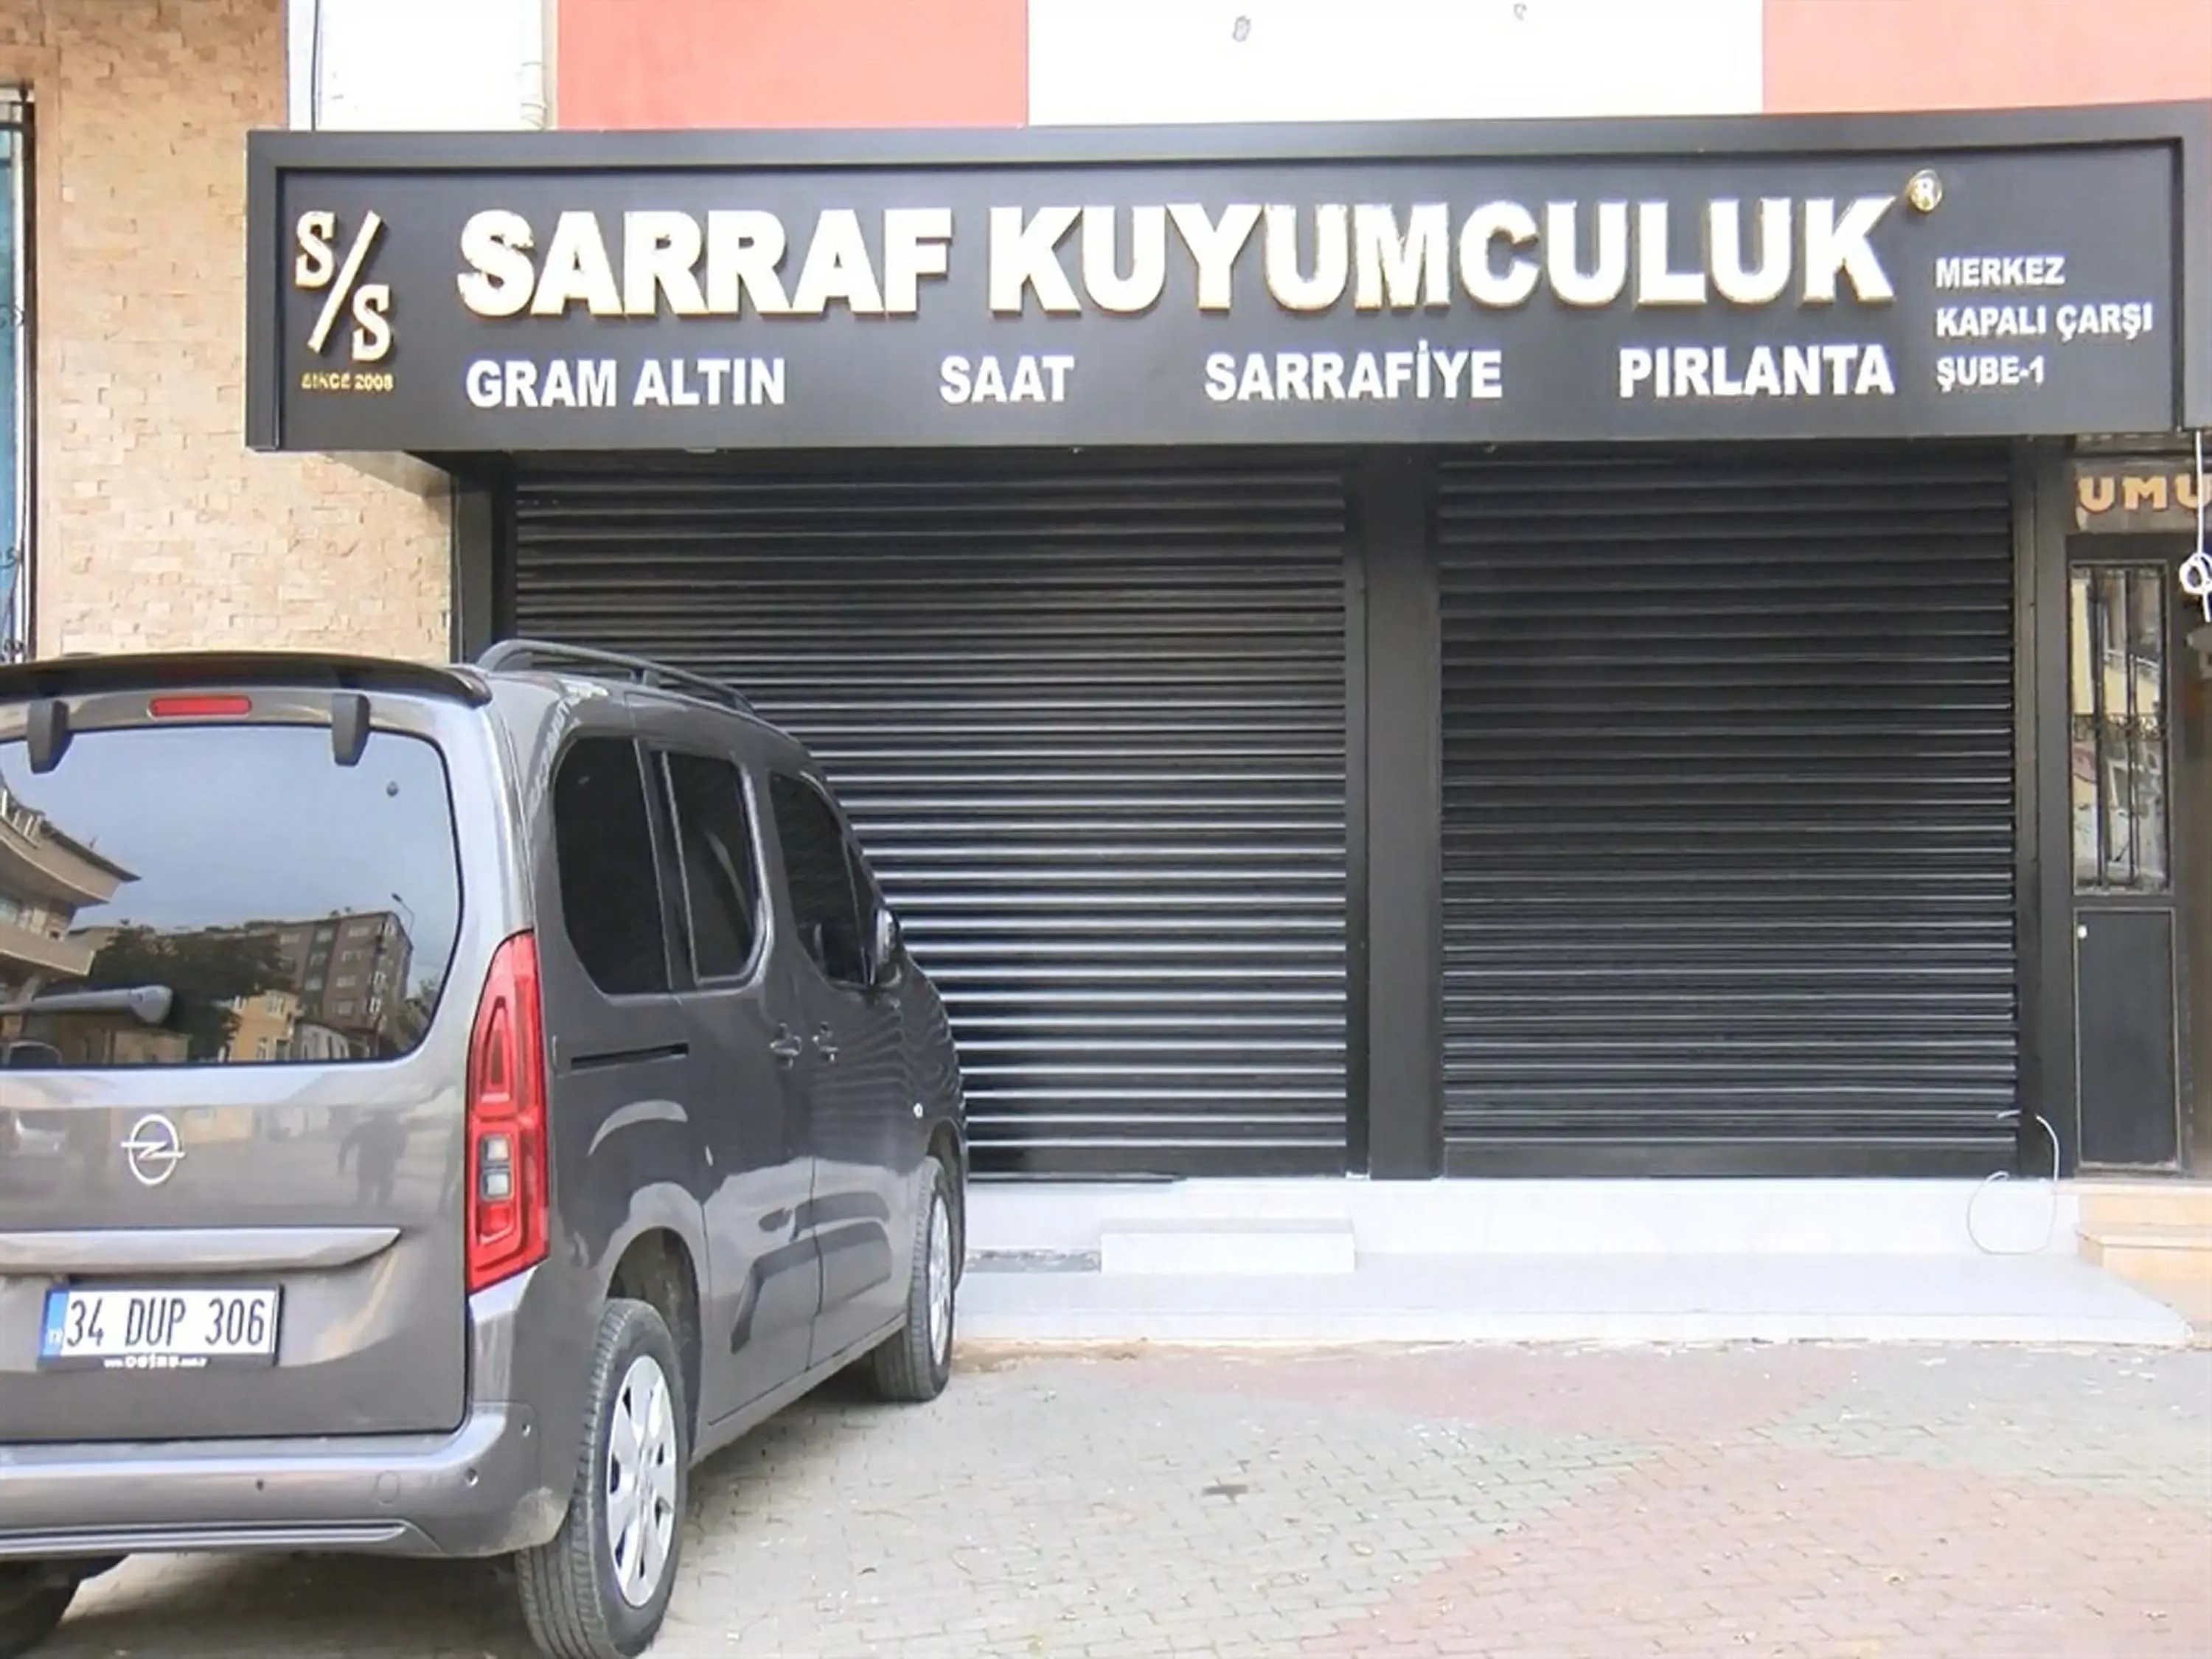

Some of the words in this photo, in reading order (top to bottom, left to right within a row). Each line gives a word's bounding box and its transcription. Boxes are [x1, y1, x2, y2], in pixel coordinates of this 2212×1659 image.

[456, 208, 953, 317] SARRAF
[989, 195, 1896, 313] KUYUMCULUK
[1935, 255, 2066, 288] MERKEZ
[1935, 305, 2047, 338] KAPALI
[2056, 302, 2154, 341] ÇARŞI
[465, 359, 617, 408] GRAM
[632, 358, 785, 407] ALTIN
[939, 354, 1076, 405] SAAT
[1204, 339, 1503, 403] SARRAFİYE
[1619, 344, 1896, 398] PIRLANTA
[1936, 355, 2045, 393] ŞUBE-1
[66, 1297, 105, 1347] 34
[124, 1296, 186, 1347] DUP
[204, 1297, 266, 1346] 306
